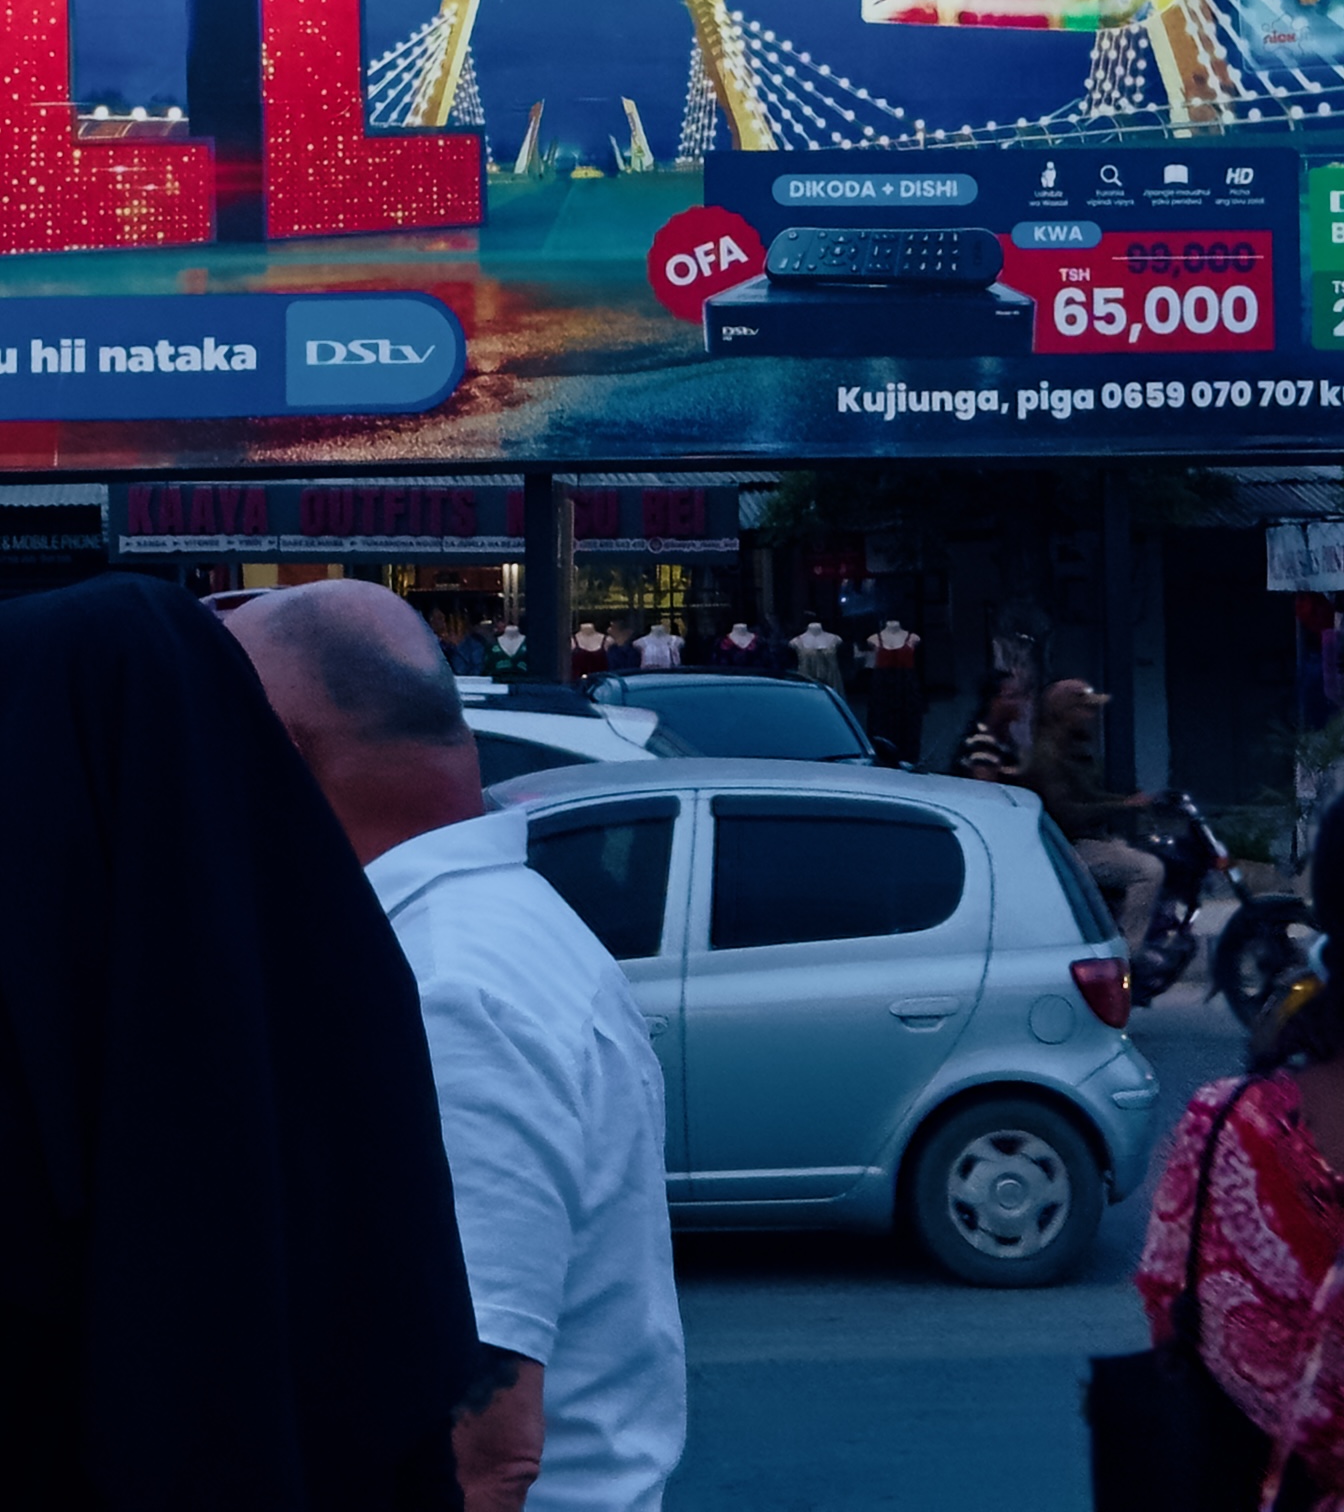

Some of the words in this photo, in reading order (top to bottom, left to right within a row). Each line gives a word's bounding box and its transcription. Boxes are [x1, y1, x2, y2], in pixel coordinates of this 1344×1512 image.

[789, 180, 876, 198] DIKODA
[900, 179, 958, 197] DISHI
[1226, 167, 1254, 184] HD
[1033, 225, 1083, 241] KWA
[665, 235, 750, 286] OFA
[1126, 242, 1255, 278] 99,000
[1059, 268, 1091, 282] TSH
[1054, 285, 1259, 343] 65,000
[722, 326, 759, 336] DStv
[31, 337, 86, 374] hii
[99, 335, 258, 373] nataka
[305, 340, 436, 366] DStv
[837, 382, 1010, 420] Kujiunga,
[1017, 381, 1094, 419] piga
[1101, 381, 1186, 410] 0659
[1190, 381, 1253, 409] 070
[1258, 379, 1314, 408] 707
[128, 487, 268, 535] KAAYA
[301, 487, 475, 536] OUTFITS
[641, 488, 705, 536] BEI
[12, 535, 59, 550] MOBILE
